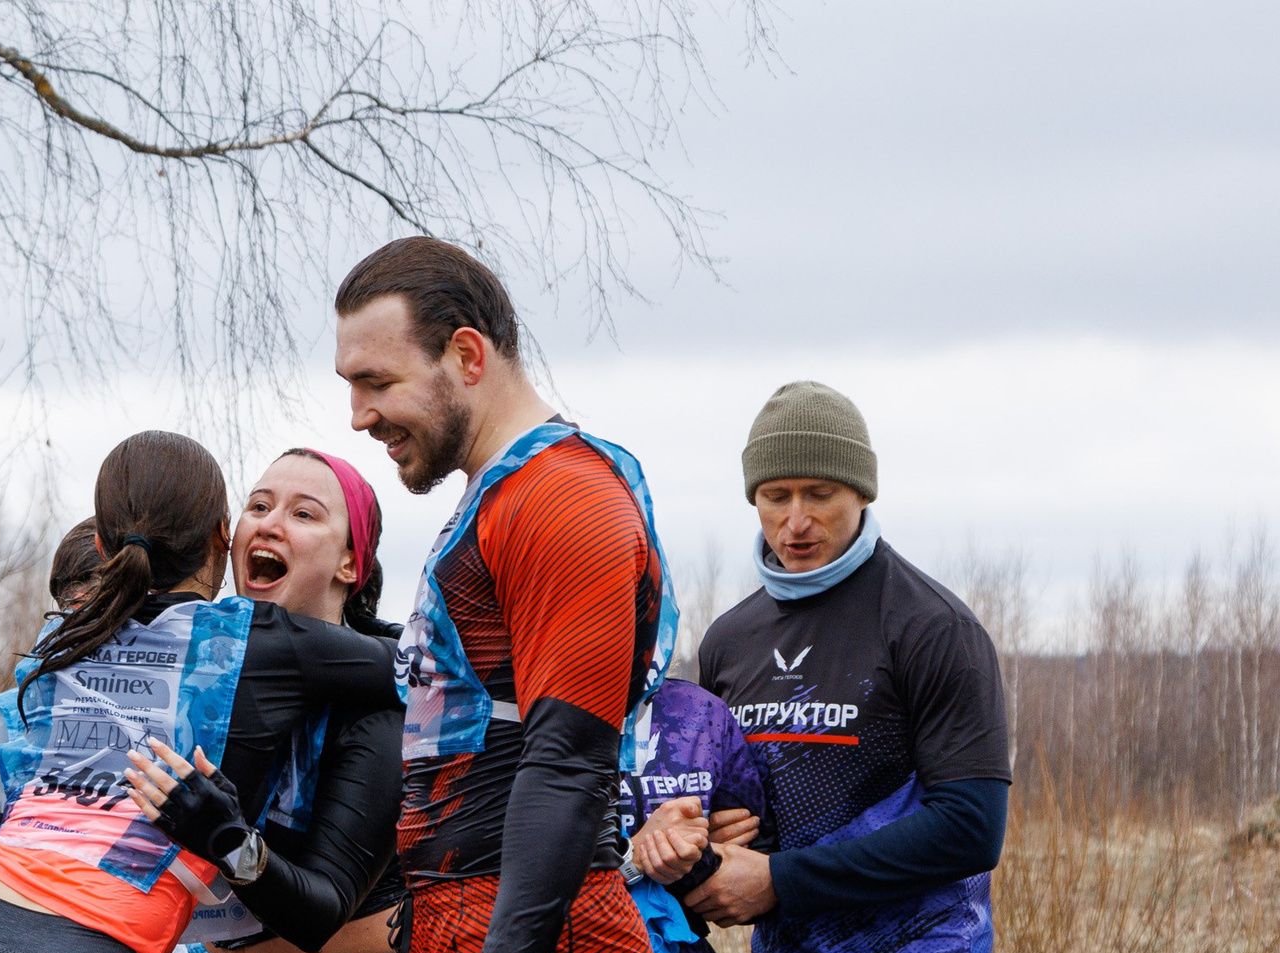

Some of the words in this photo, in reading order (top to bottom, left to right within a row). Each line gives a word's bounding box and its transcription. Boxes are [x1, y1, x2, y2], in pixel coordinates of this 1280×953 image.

[118, 650, 177, 664] ГЕРОЕВ
[73, 670, 154, 695] Sminex
[93, 708, 150, 723] DEVELOPMENT
[728, 702, 858, 727] НСТРУКТОР
[640, 772, 713, 795] ГЕРОЕВ
